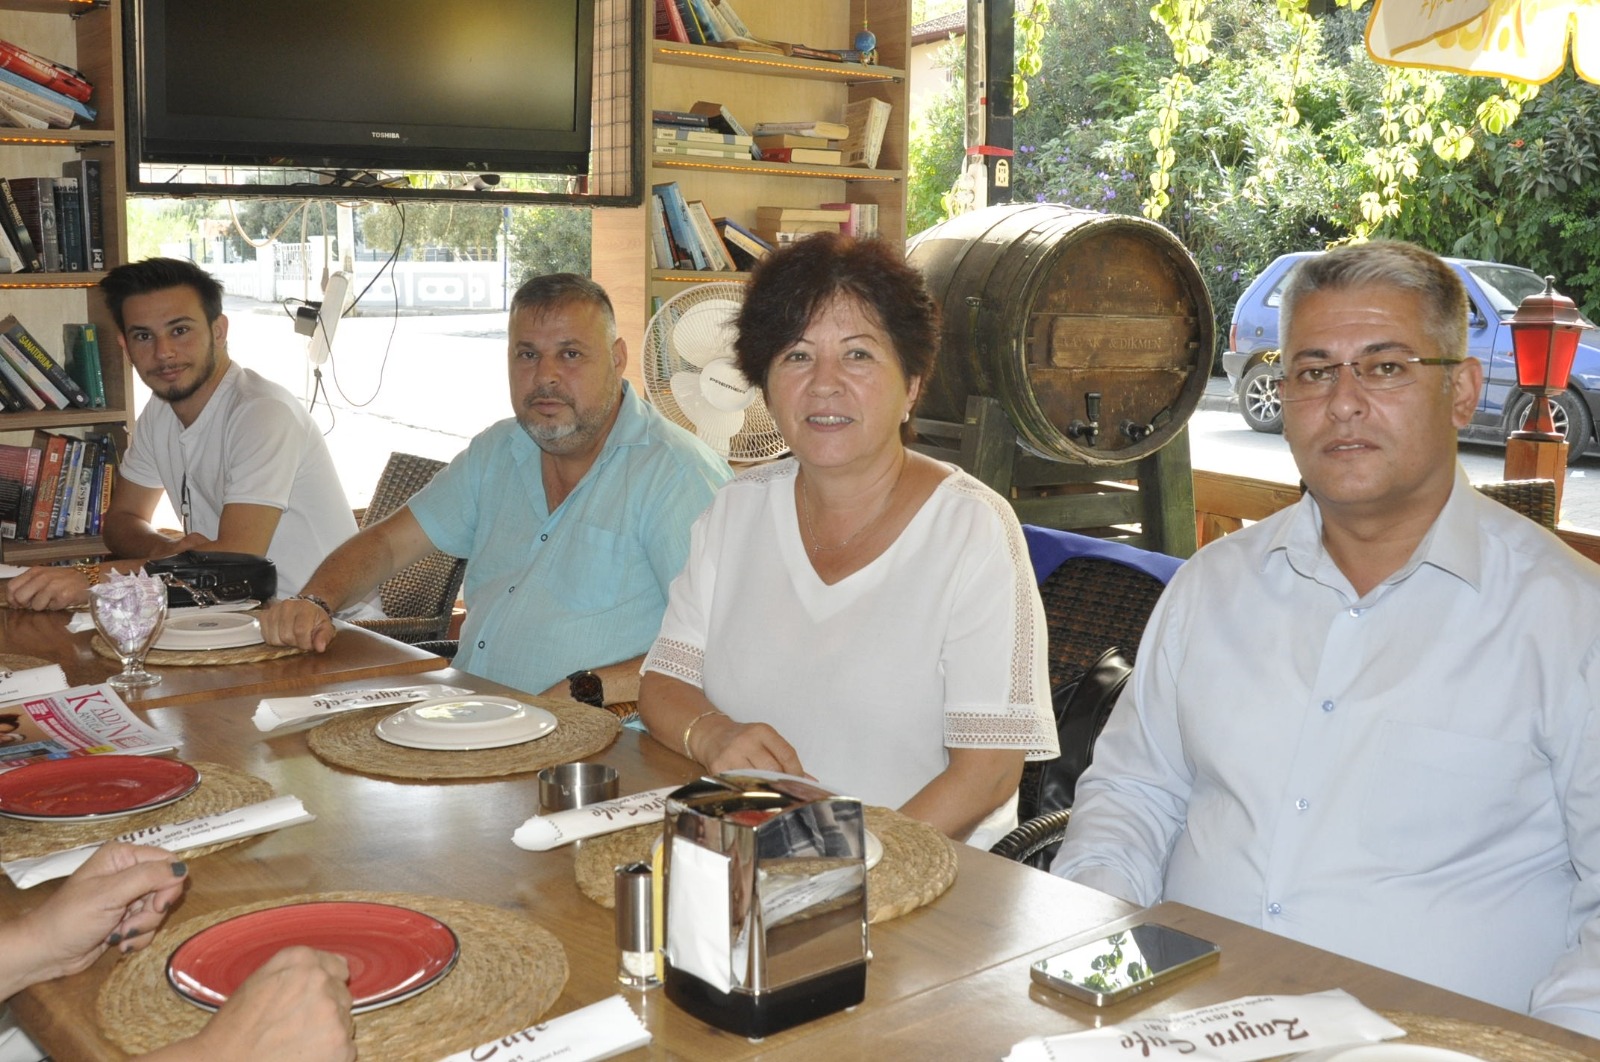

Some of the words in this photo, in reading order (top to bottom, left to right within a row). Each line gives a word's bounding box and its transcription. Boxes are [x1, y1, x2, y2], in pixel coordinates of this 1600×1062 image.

[371, 131, 401, 139] TOSHIBA
[9, 203, 25, 227] CONNELLY
[18, 335, 54, 370] SANATORIUM
[65, 690, 143, 738] KADIN
[114, 826, 163, 845] yra
[1120, 1031, 1197, 1058] Cafe
[1205, 1017, 1310, 1048] Zayra
